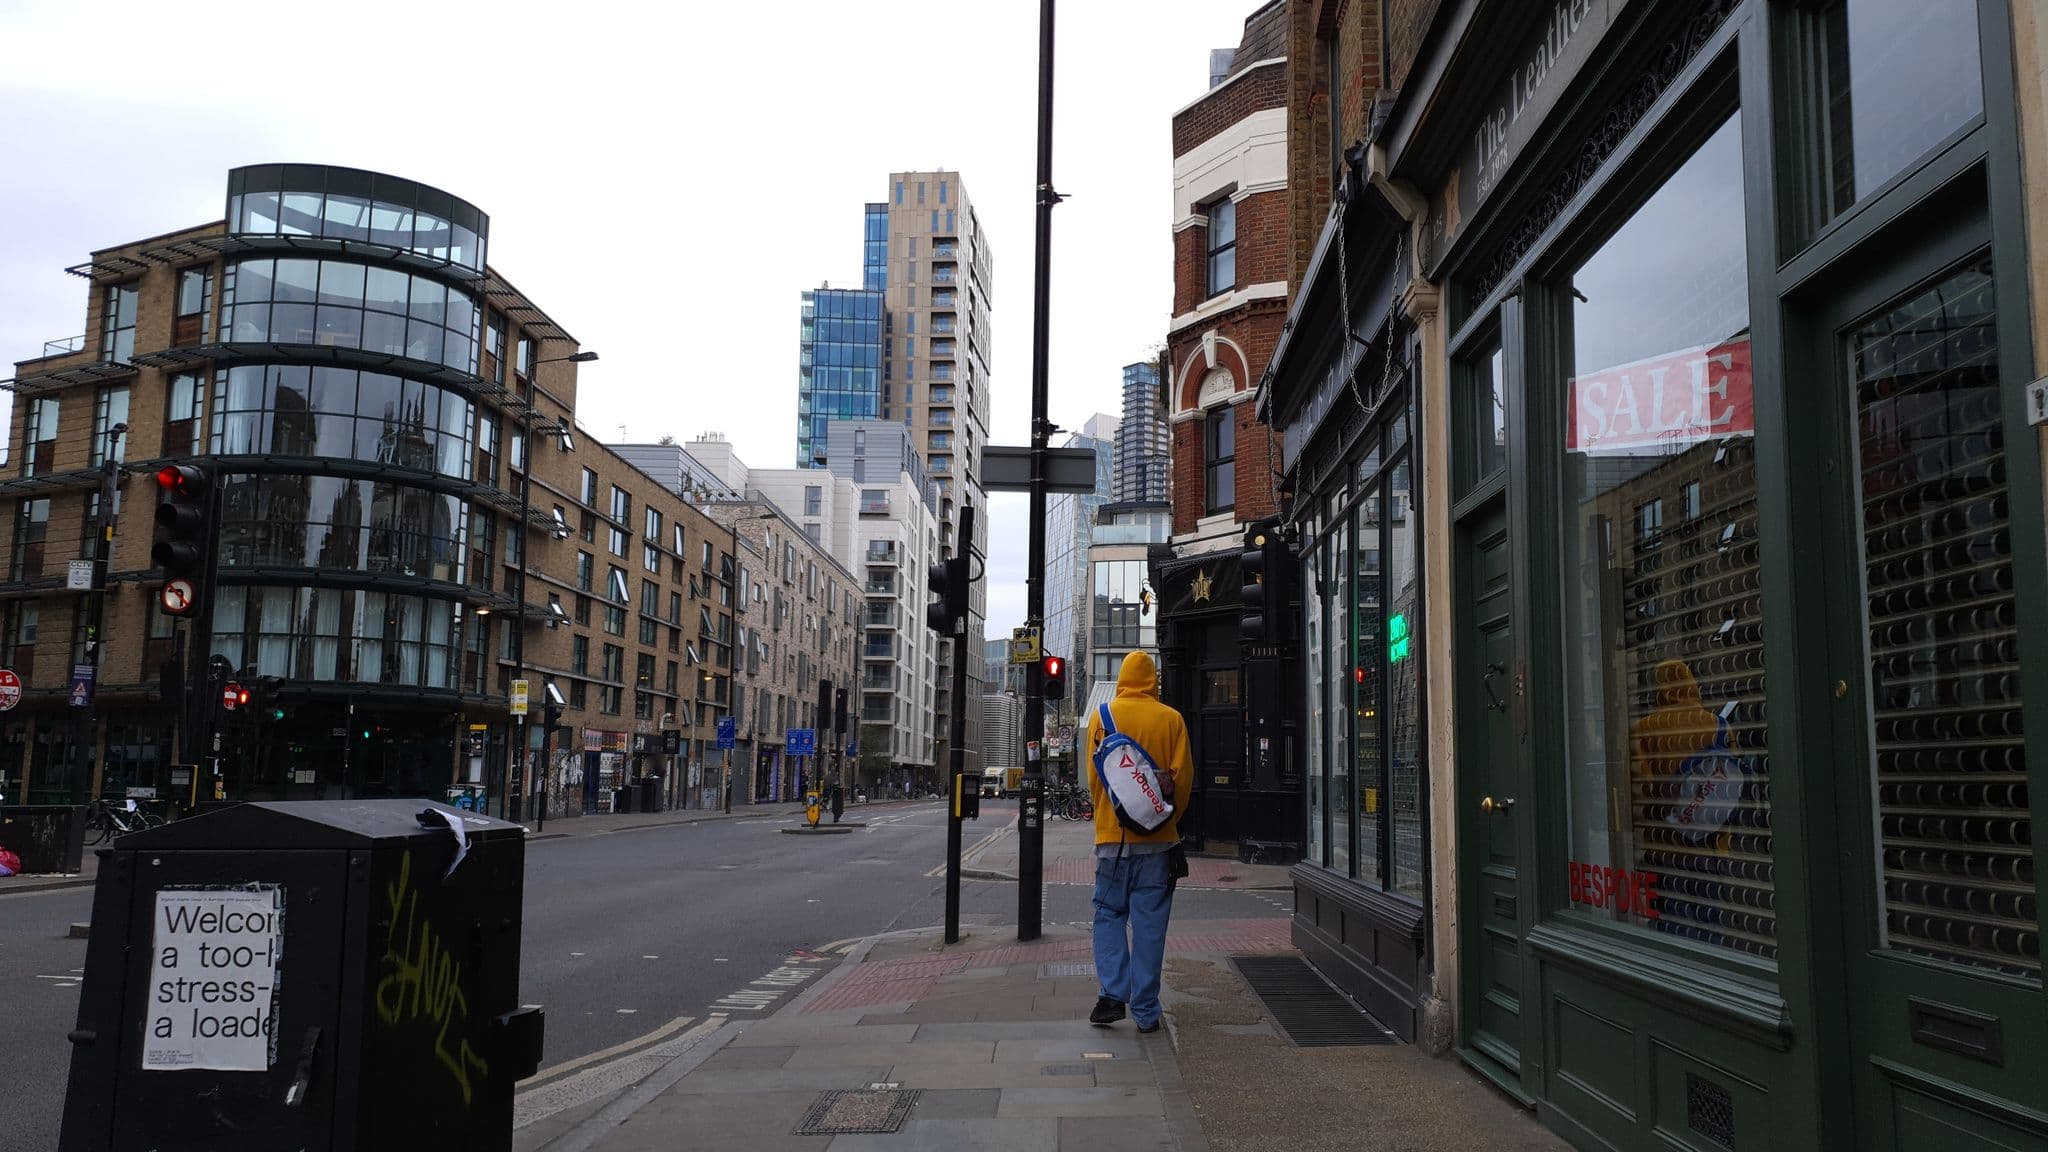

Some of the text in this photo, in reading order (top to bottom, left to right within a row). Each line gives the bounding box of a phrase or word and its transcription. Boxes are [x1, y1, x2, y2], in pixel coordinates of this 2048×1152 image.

[1474, 106, 1507, 177] The
[1582, 353, 1735, 441] SALE
[1130, 768, 1166, 815] Reebok
[1569, 861, 1660, 920] BESPOKE
[165, 904, 274, 934] Welco
[161, 946, 178, 968] a
[158, 976, 270, 1003] stress-
[155, 1016, 173, 1038] a
